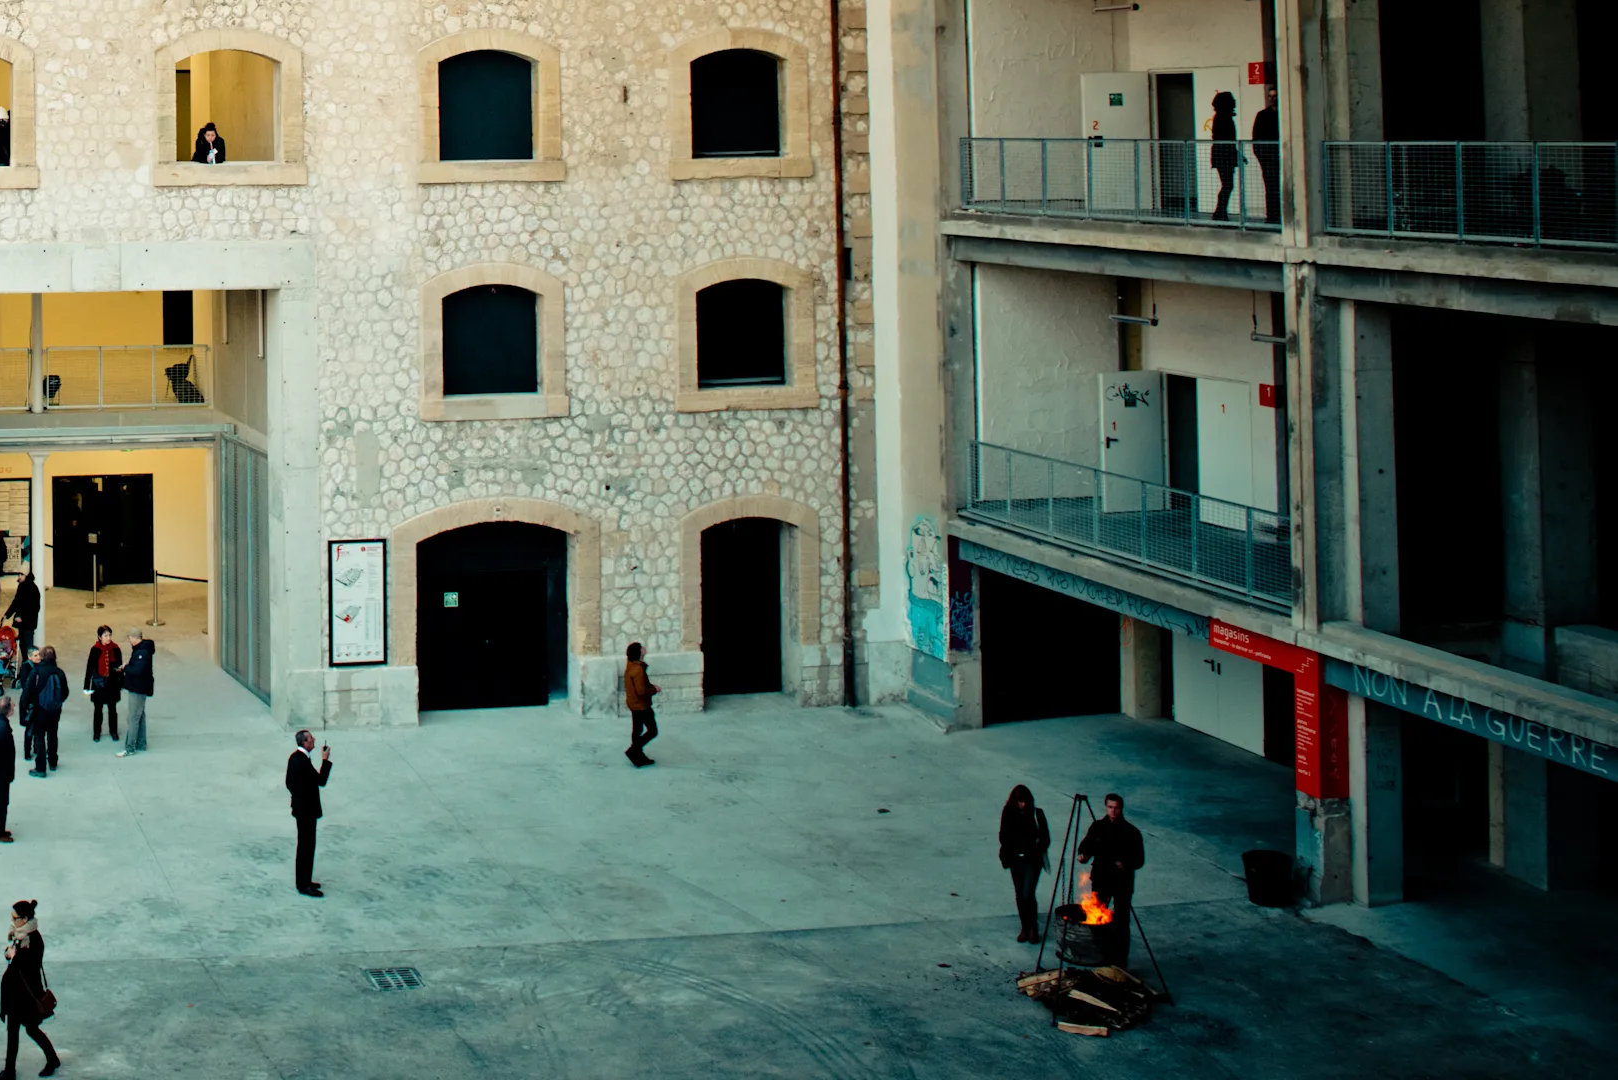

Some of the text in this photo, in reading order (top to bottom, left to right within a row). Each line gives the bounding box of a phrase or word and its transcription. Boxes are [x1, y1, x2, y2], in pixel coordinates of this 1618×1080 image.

[1254, 63, 1261, 75] 2
[1092, 120, 1099, 131] 2
[1266, 386, 1271, 398] 1
[1221, 403, 1226, 414] 1
[1112, 421, 1117, 431] 1
[1213, 624, 1250, 644] magasins
[1351, 663, 1408, 706] NON
[1423, 688, 1443, 720] A
[1449, 696, 1476, 730] LA
[1485, 708, 1610, 774] GUERRE
